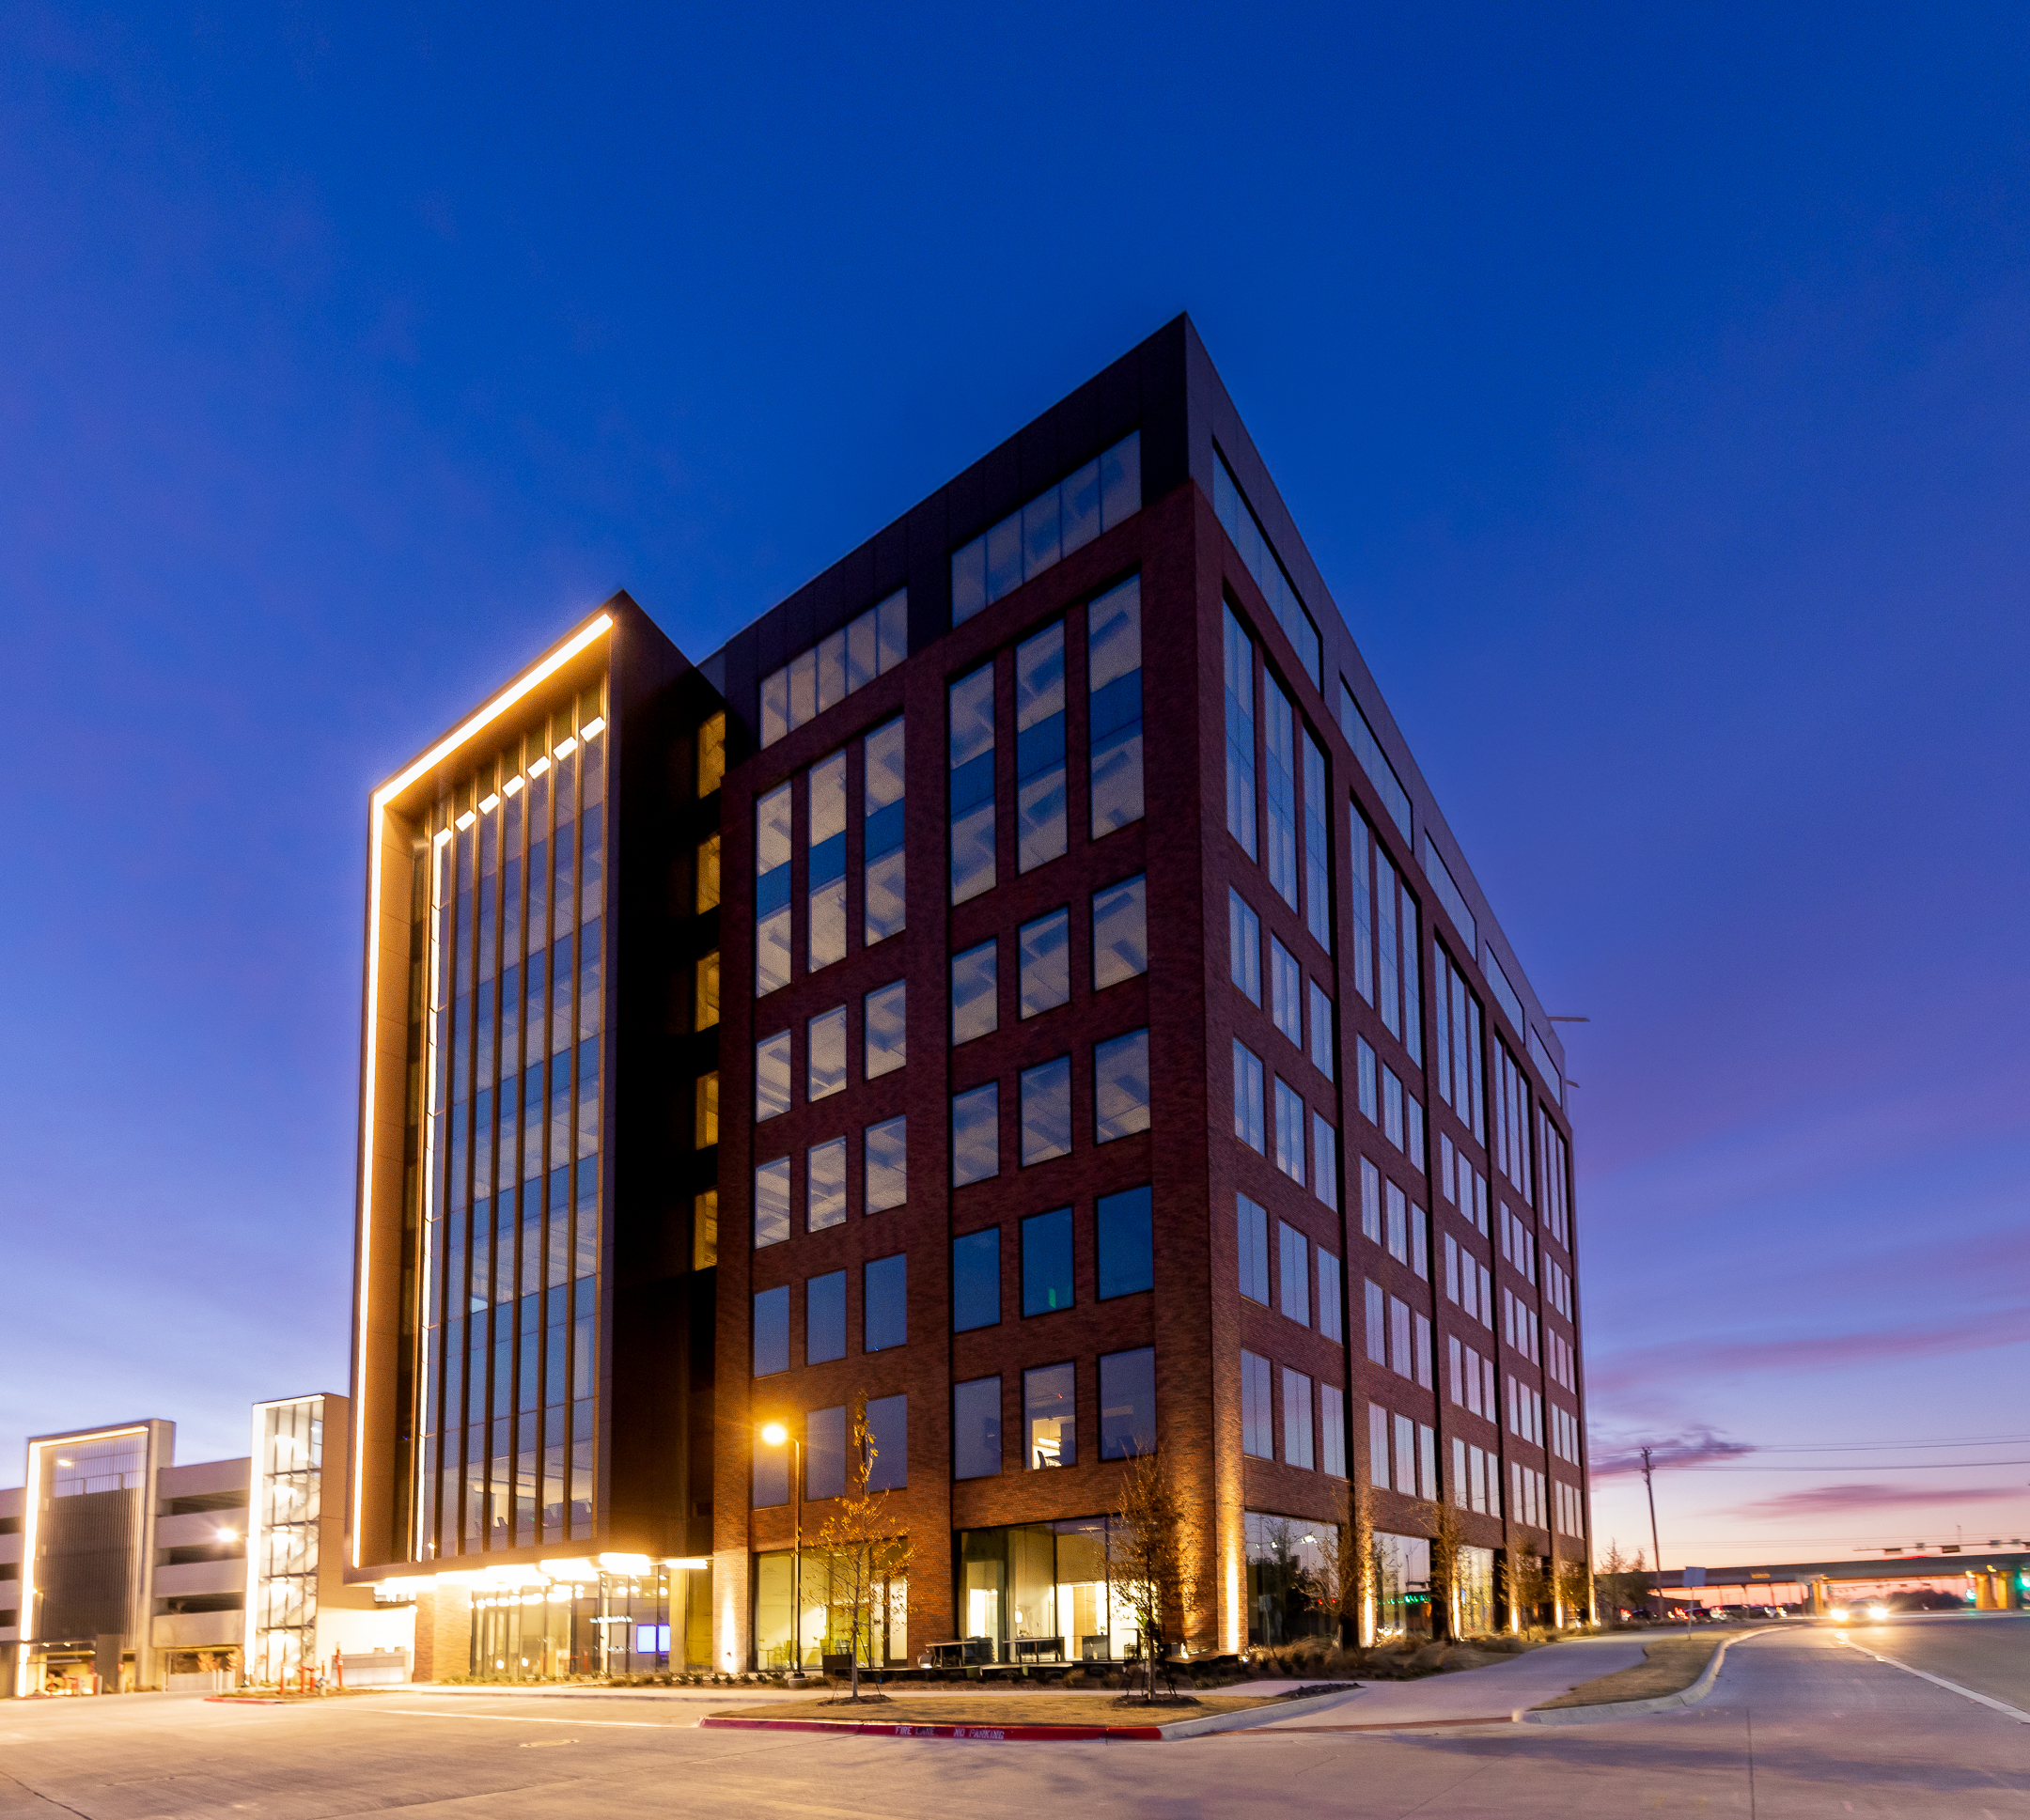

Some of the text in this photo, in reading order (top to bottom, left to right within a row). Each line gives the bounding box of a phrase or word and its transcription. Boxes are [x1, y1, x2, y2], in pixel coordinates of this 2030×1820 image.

[895, 1725, 1005, 1739] FIRE LANE NO PARKING
